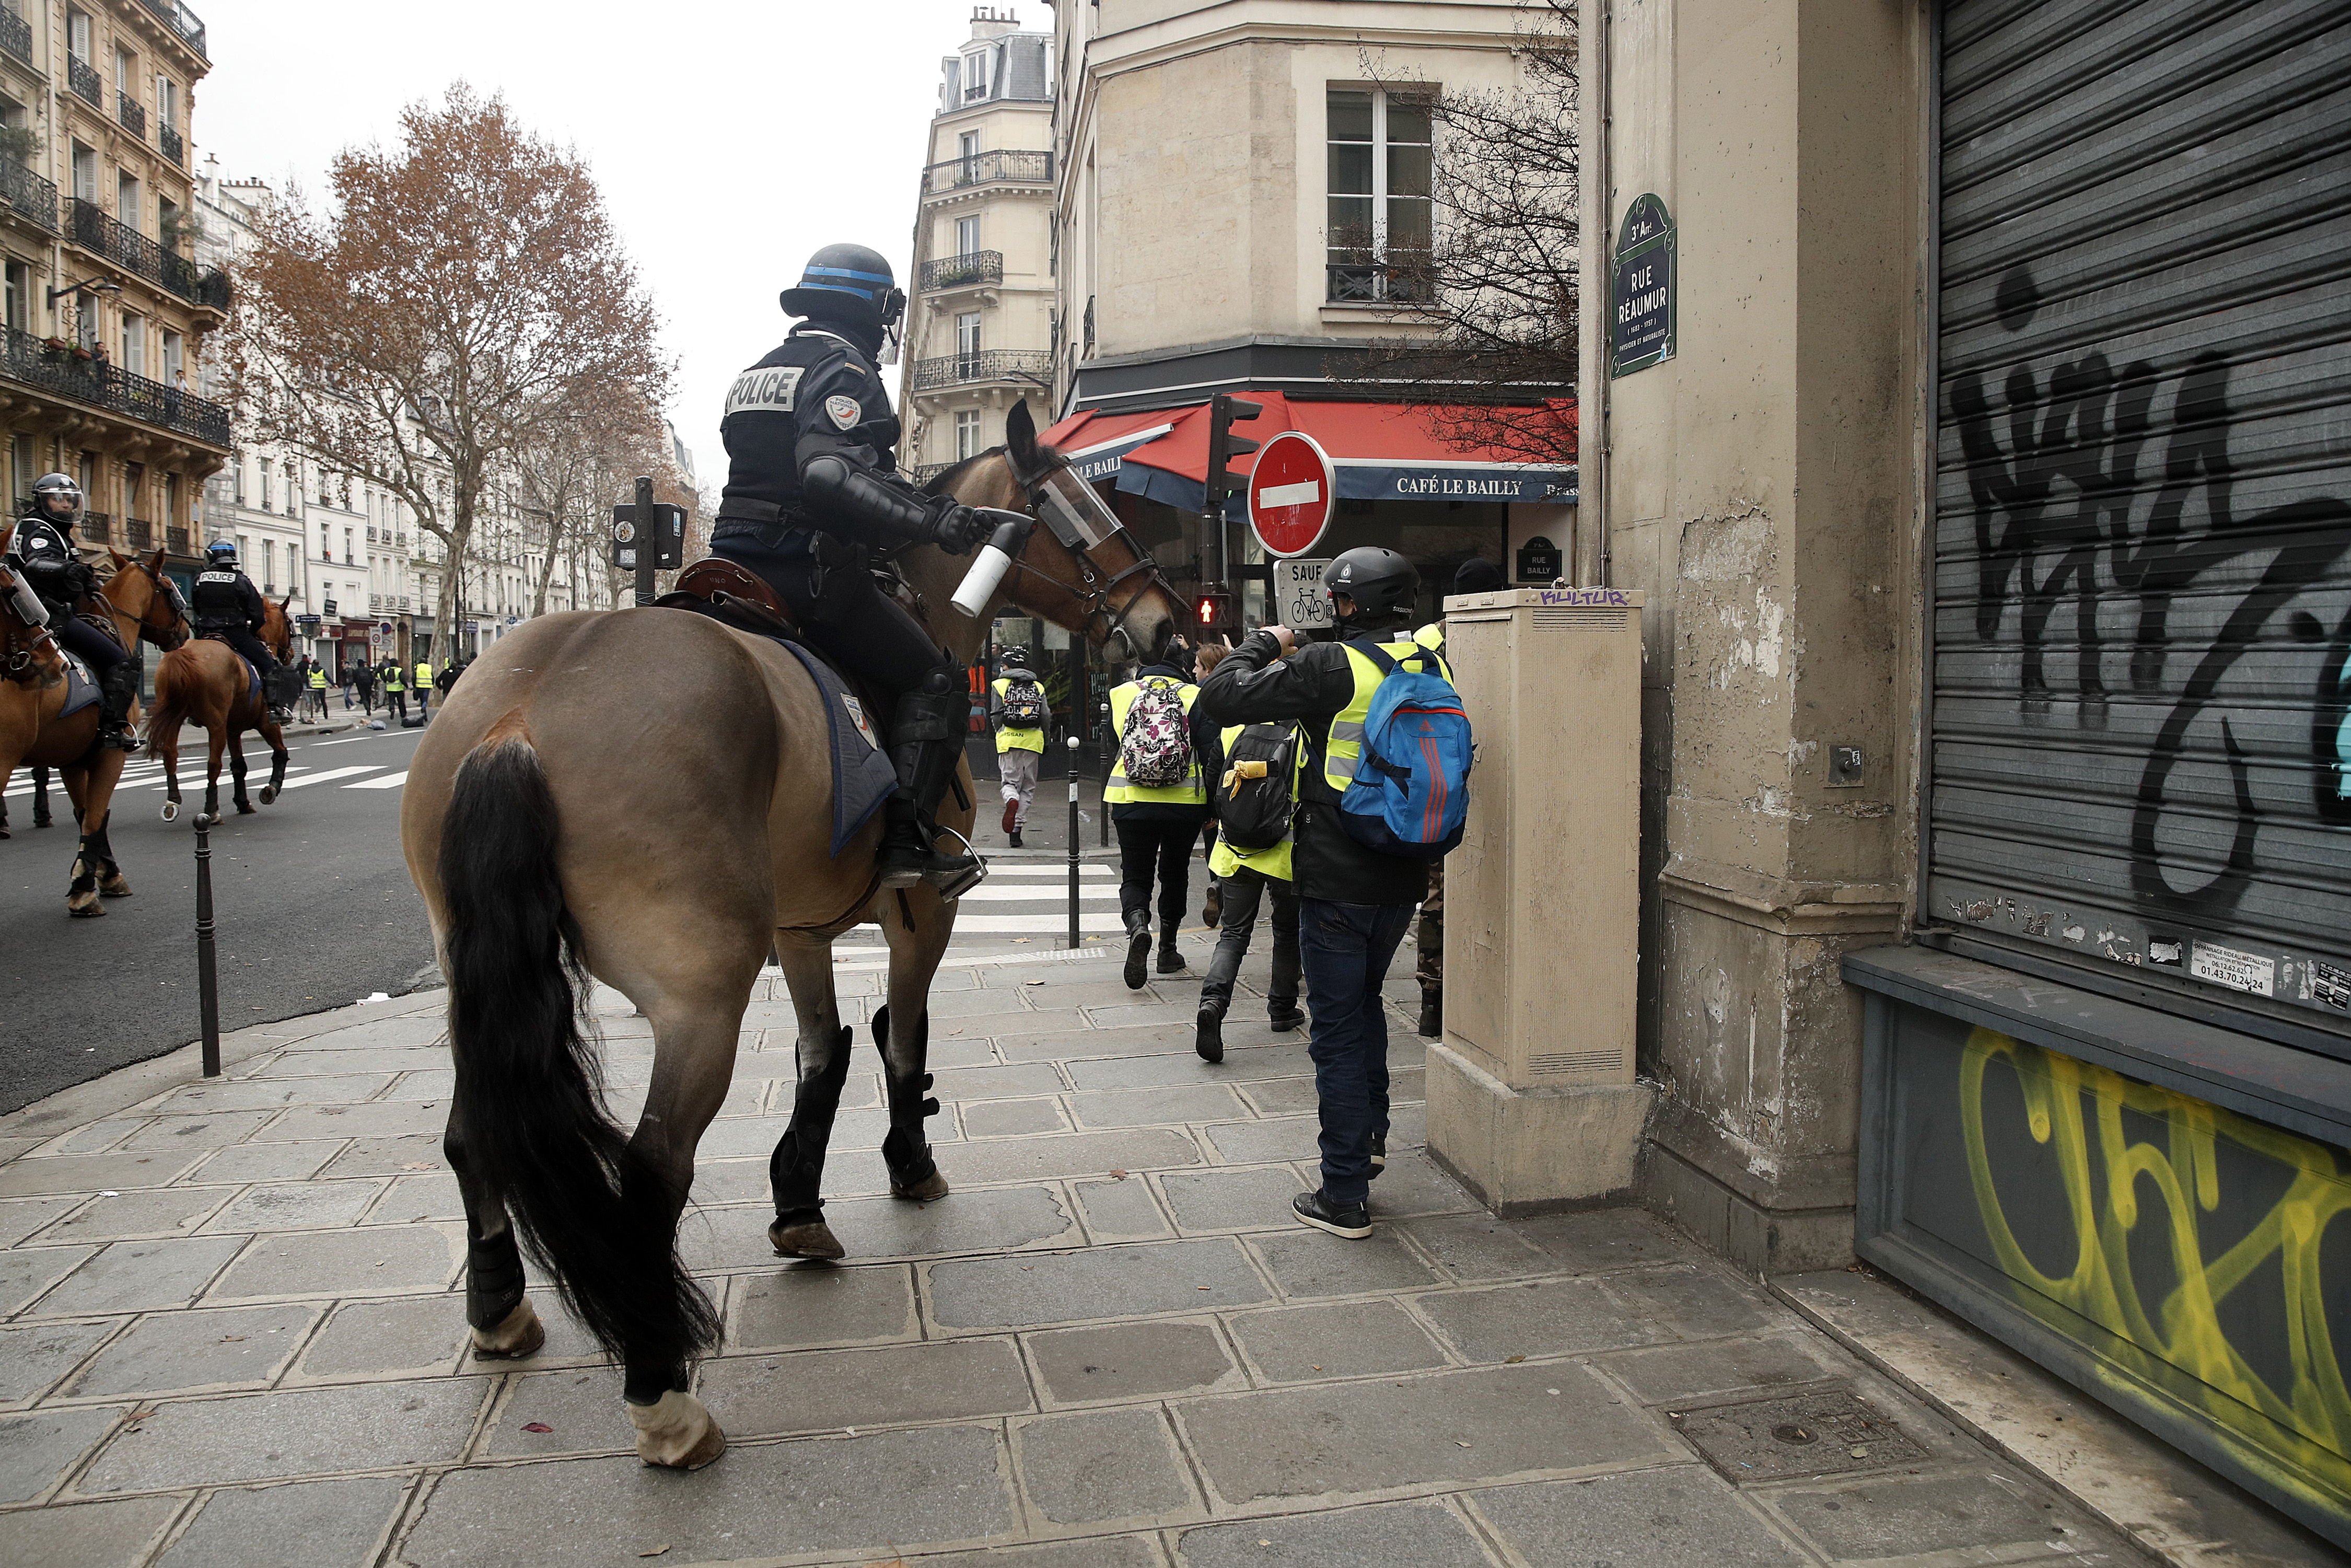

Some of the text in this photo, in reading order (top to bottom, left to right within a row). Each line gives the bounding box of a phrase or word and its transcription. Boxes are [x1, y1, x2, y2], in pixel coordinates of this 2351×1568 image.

[1632, 265, 1652, 293] RUE
[1619, 287, 1666, 324] RÉAUMUR
[1619, 342, 1636, 352] PHYSICIEN
[1643, 328, 1666, 342] NATURALISTE
[729, 373, 795, 408] POLICE
[830, 401, 857, 411] NATIONALE
[1397, 475, 1522, 495] CAFÉ LE BAILLY
[1292, 565, 1322, 581] SAUF
[1540, 590, 1627, 606] KULTUR
[2194, 943, 2273, 968] DÉPANNAGE RIDEAU MÉTALLIQUE
[2206, 953, 2231, 963] INSTALLATION
